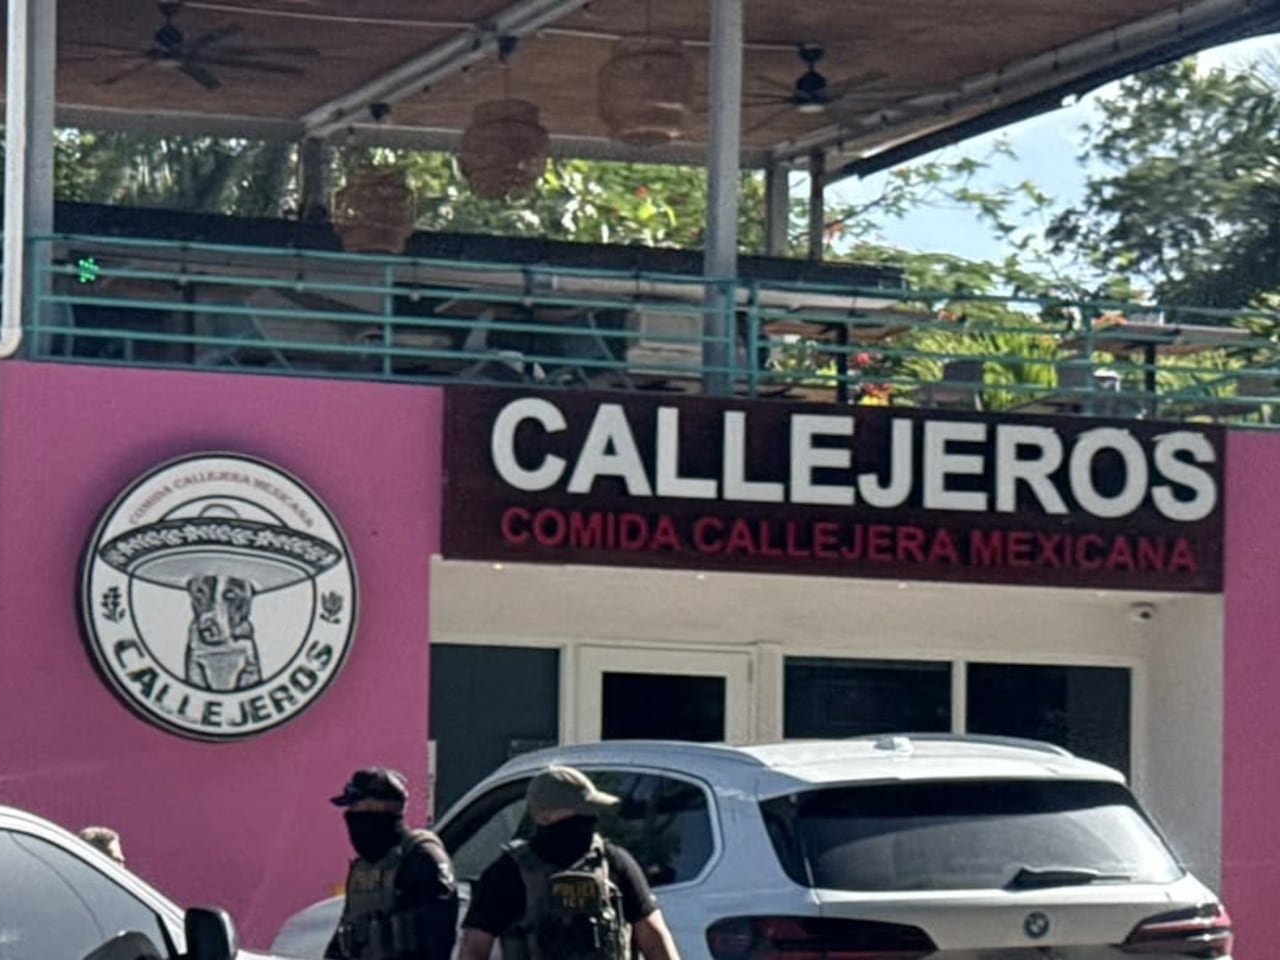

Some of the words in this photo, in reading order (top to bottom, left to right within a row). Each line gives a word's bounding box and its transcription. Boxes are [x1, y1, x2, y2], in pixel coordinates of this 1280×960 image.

[491, 396, 1218, 522] CALLEJEROS
[501, 507, 682, 553] COMIDA
[693, 516, 959, 564] CALLEJERA
[969, 529, 1200, 573] MEXICANA
[113, 637, 334, 728] CALLEJEROS
